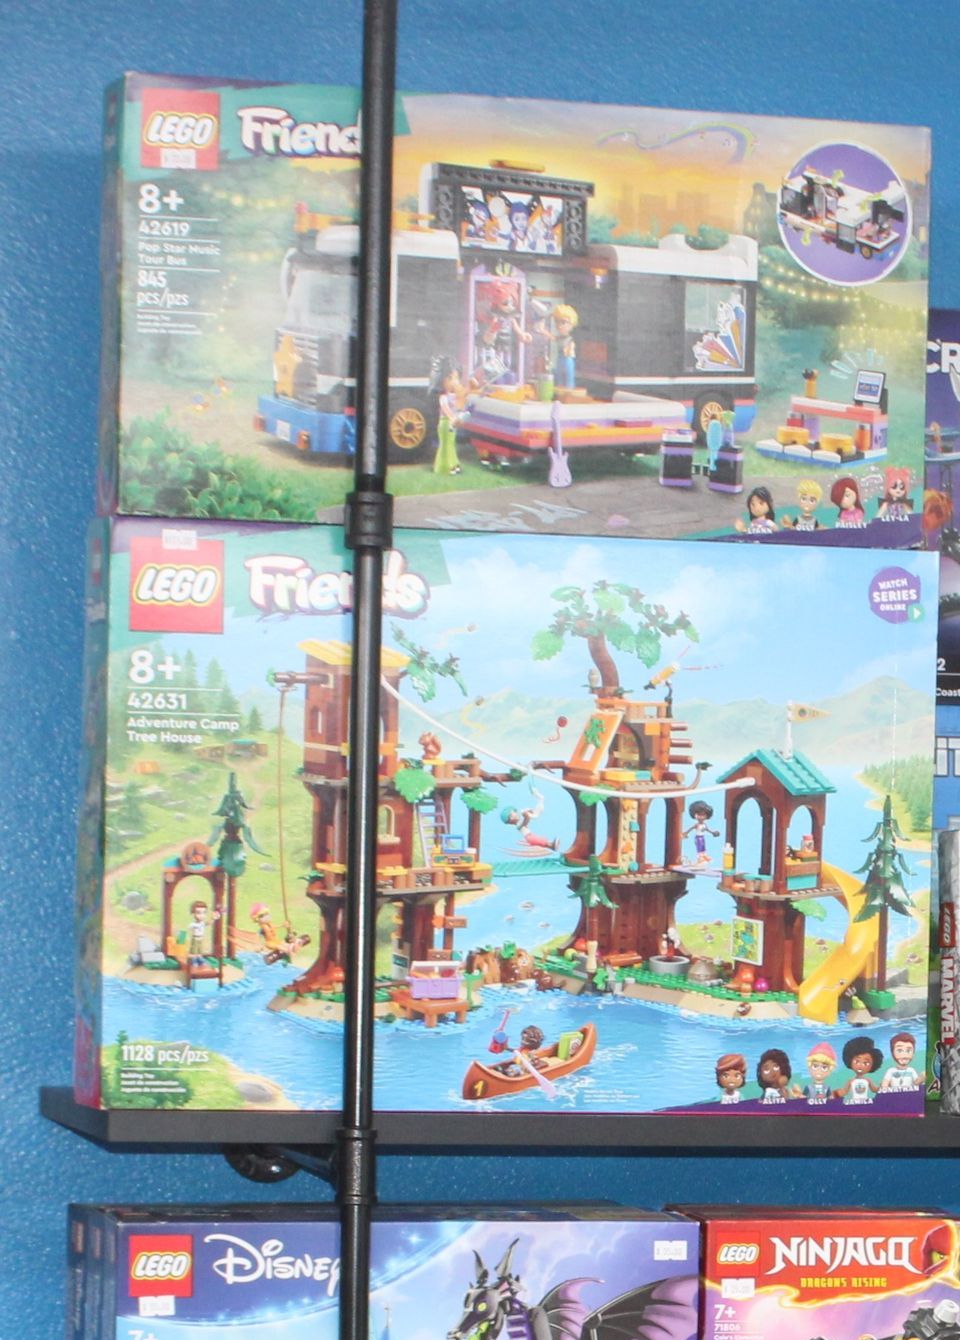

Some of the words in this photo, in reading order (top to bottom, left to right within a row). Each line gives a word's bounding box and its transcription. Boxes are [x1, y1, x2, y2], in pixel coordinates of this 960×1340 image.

[146, 113, 217, 146] LEGO
[238, 106, 361, 157] Friend
[139, 184, 184, 213] 8+
[139, 222, 190, 237] 42619
[139, 242, 158, 255] Pop
[162, 241, 185, 253] Star
[189, 244, 220, 256] Music
[139, 253, 163, 265] Tour
[166, 255, 187, 266] Bus
[138, 272, 166, 288] 845
[137, 289, 190, 307] pcs/pzs
[136, 567, 218, 603] LEGO
[873, 589, 918, 602] SERIES
[129, 651, 181, 685] 8+
[127, 693, 187, 710] 42631
[127, 717, 197, 730] Adventure
[201, 718, 239, 732] Camp
[128, 731, 149, 743] Tree
[154, 731, 202, 744] House
[941, 958, 956, 1044] MARVEL
[122, 1045, 154, 1062] 1128
[157, 1044, 209, 1066] pcs/pzs
[718, 1244, 759, 1264] LEGO
[765, 1237, 924, 1275] NINJAGO
[132, 1253, 190, 1279] LEGO
[801, 1278, 847, 1288] DRAGONS
[852, 1278, 888, 1288] RISING
[714, 1304, 736, 1320] 7+
[714, 1324, 740, 1332] 71806
